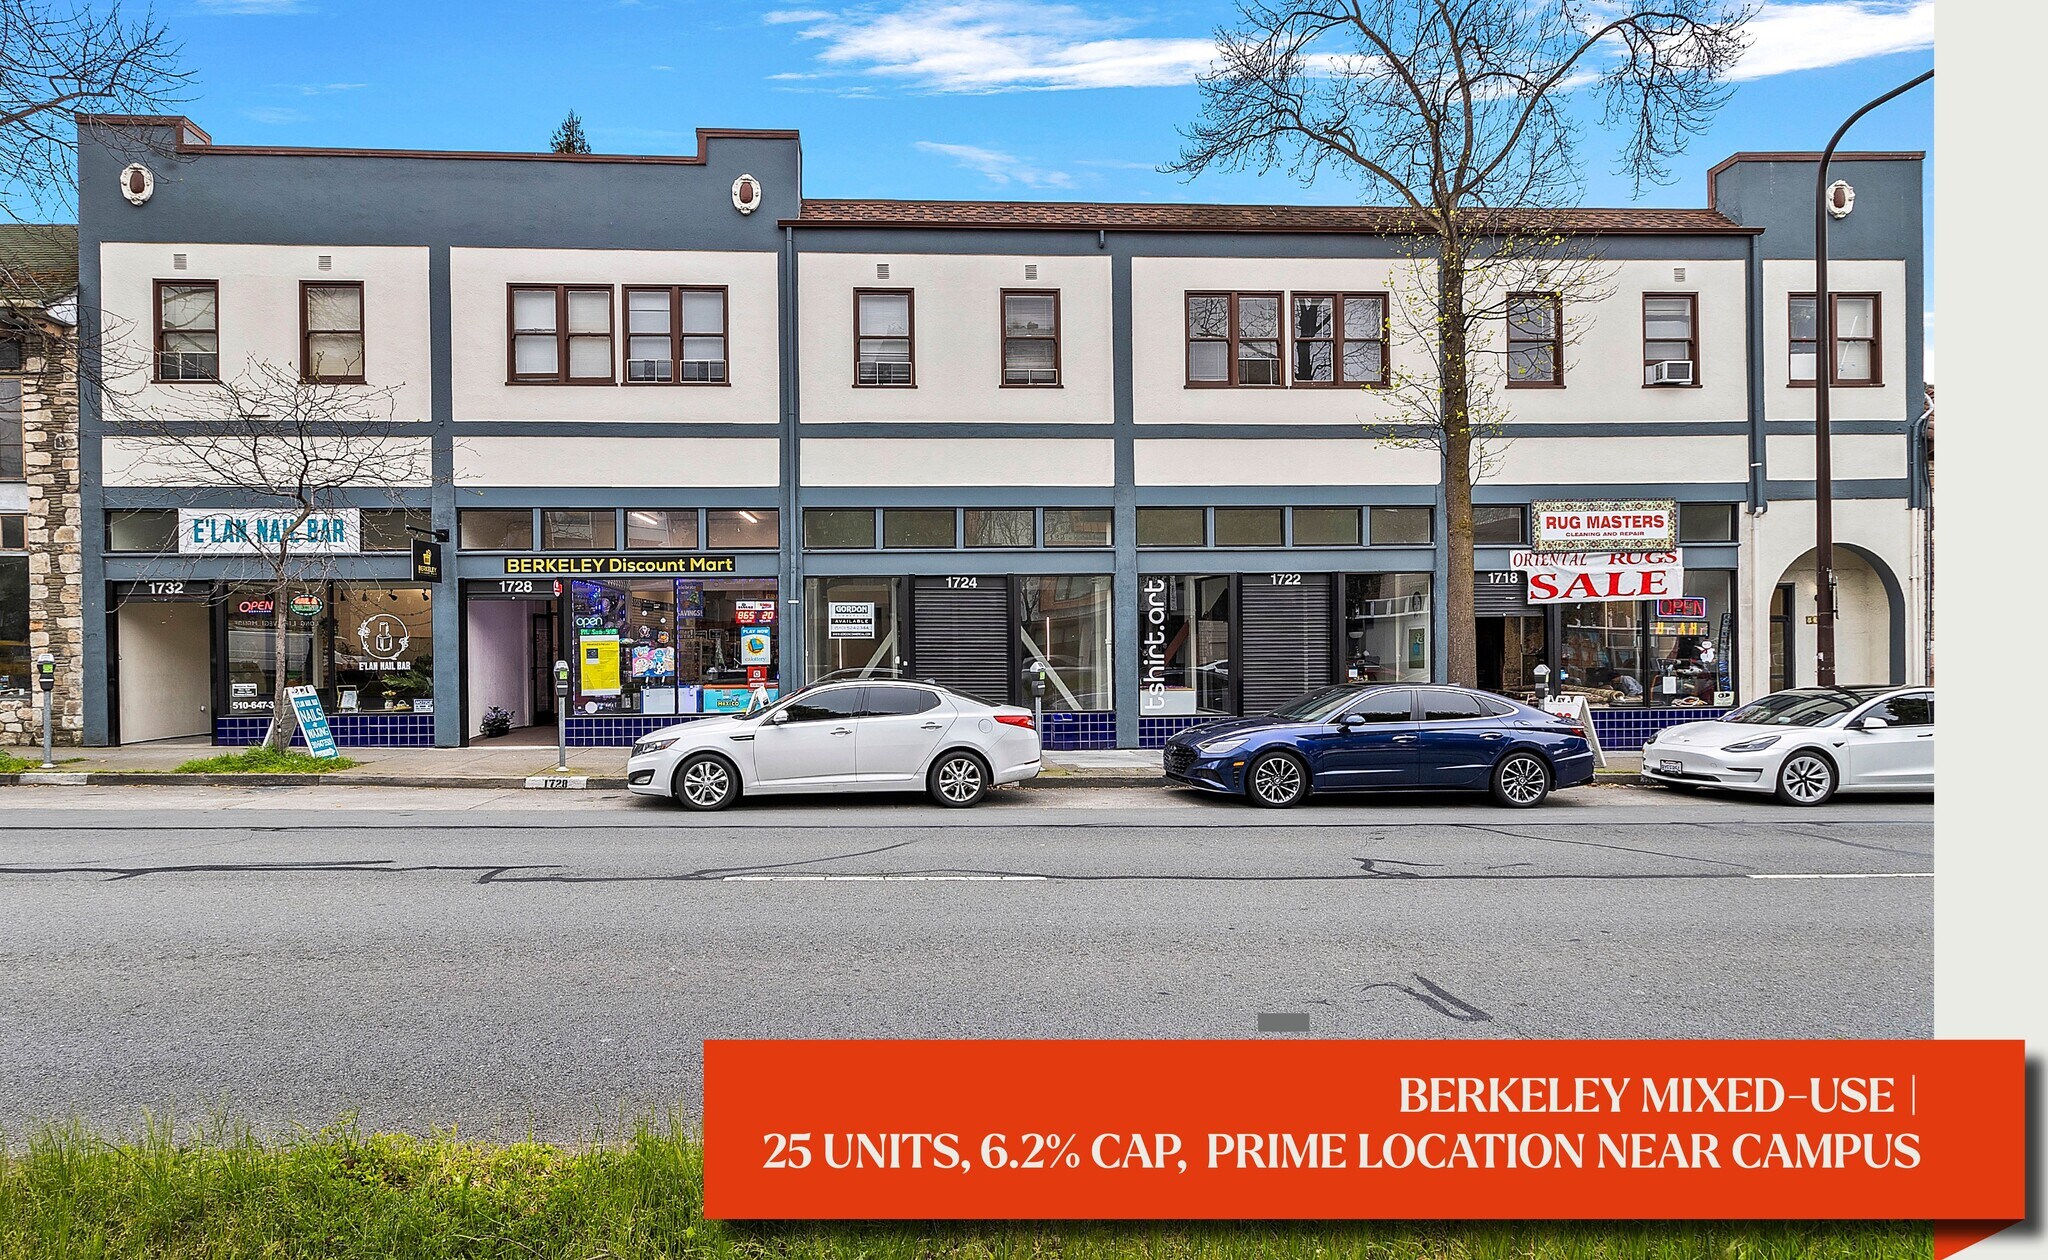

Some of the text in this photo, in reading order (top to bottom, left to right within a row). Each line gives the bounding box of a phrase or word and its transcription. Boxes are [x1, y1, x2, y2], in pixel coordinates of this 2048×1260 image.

[1546, 515, 1664, 530] RUG MASTERS
[193, 518, 346, 544] E'LAN NAIL BAR
[507, 557, 734, 573] BERKELEY Discount Mart
[1514, 550, 1678, 567] ORIENTAL RUGS
[945, 576, 978, 588] 1724
[1270, 574, 1301, 585] 1722
[1488, 572, 1518, 584] 1718
[149, 582, 184, 595] 1732
[499, 581, 533, 593] 1728
[1530, 570, 1668, 600] SALE
[239, 601, 274, 613] OPEN
[1660, 599, 1704, 616] OPEN
[576, 617, 603, 628] open
[1143, 579, 1165, 710] tshirt.art
[359, 662, 411, 670] E'LAN NAIL BAR
[299, 708, 324, 723] NAILS
[306, 726, 329, 739] WAXING
